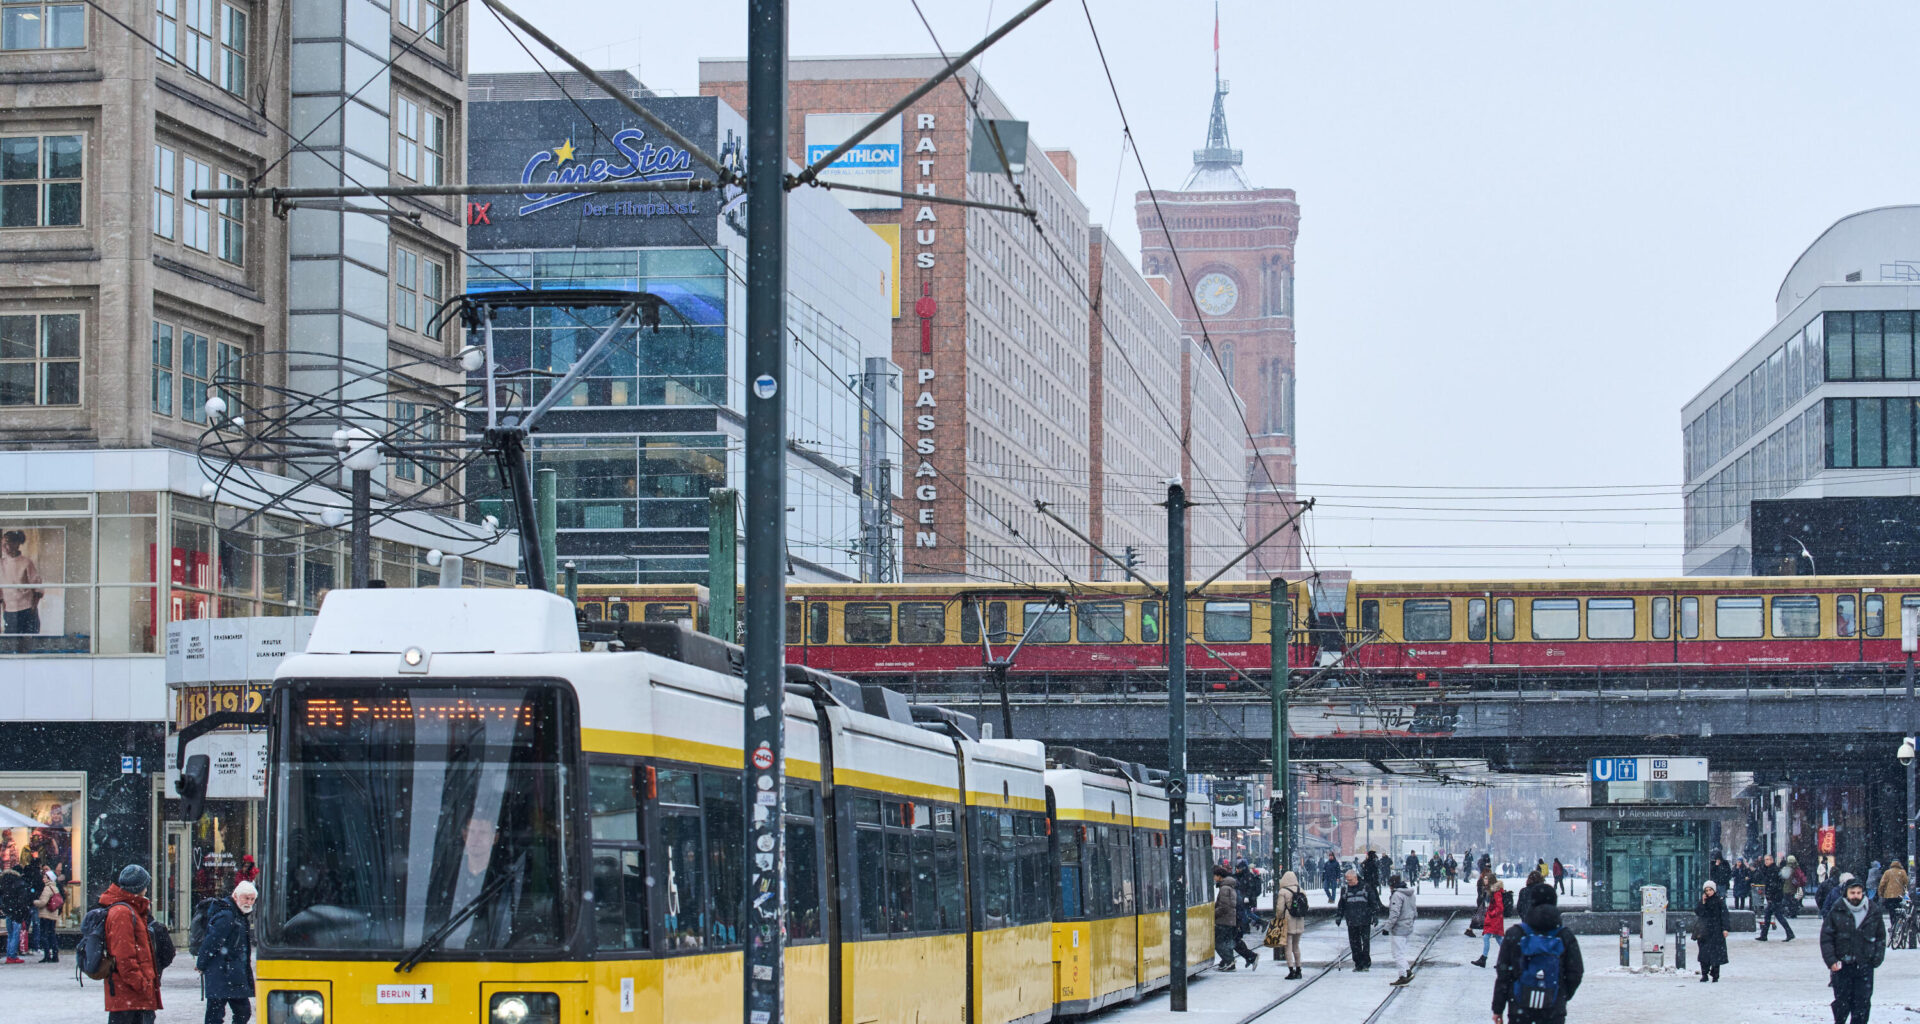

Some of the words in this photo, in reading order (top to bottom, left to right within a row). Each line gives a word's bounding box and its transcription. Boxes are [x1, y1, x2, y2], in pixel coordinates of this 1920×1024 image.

[521, 128, 691, 201] CineStar
[813, 149, 894, 163] DATHLON
[916, 113, 936, 268] RATHAUS
[582, 202, 608, 216] Der
[916, 368, 936, 548] PASSAGEN
[189, 692, 206, 721] 18
[213, 691, 239, 713] 19
[1595, 760, 1613, 780] U
[1654, 760, 1667, 768] U8
[1654, 771, 1667, 779] U5
[1618, 809, 1626, 818] U
[381, 990, 411, 998] BERLIN
